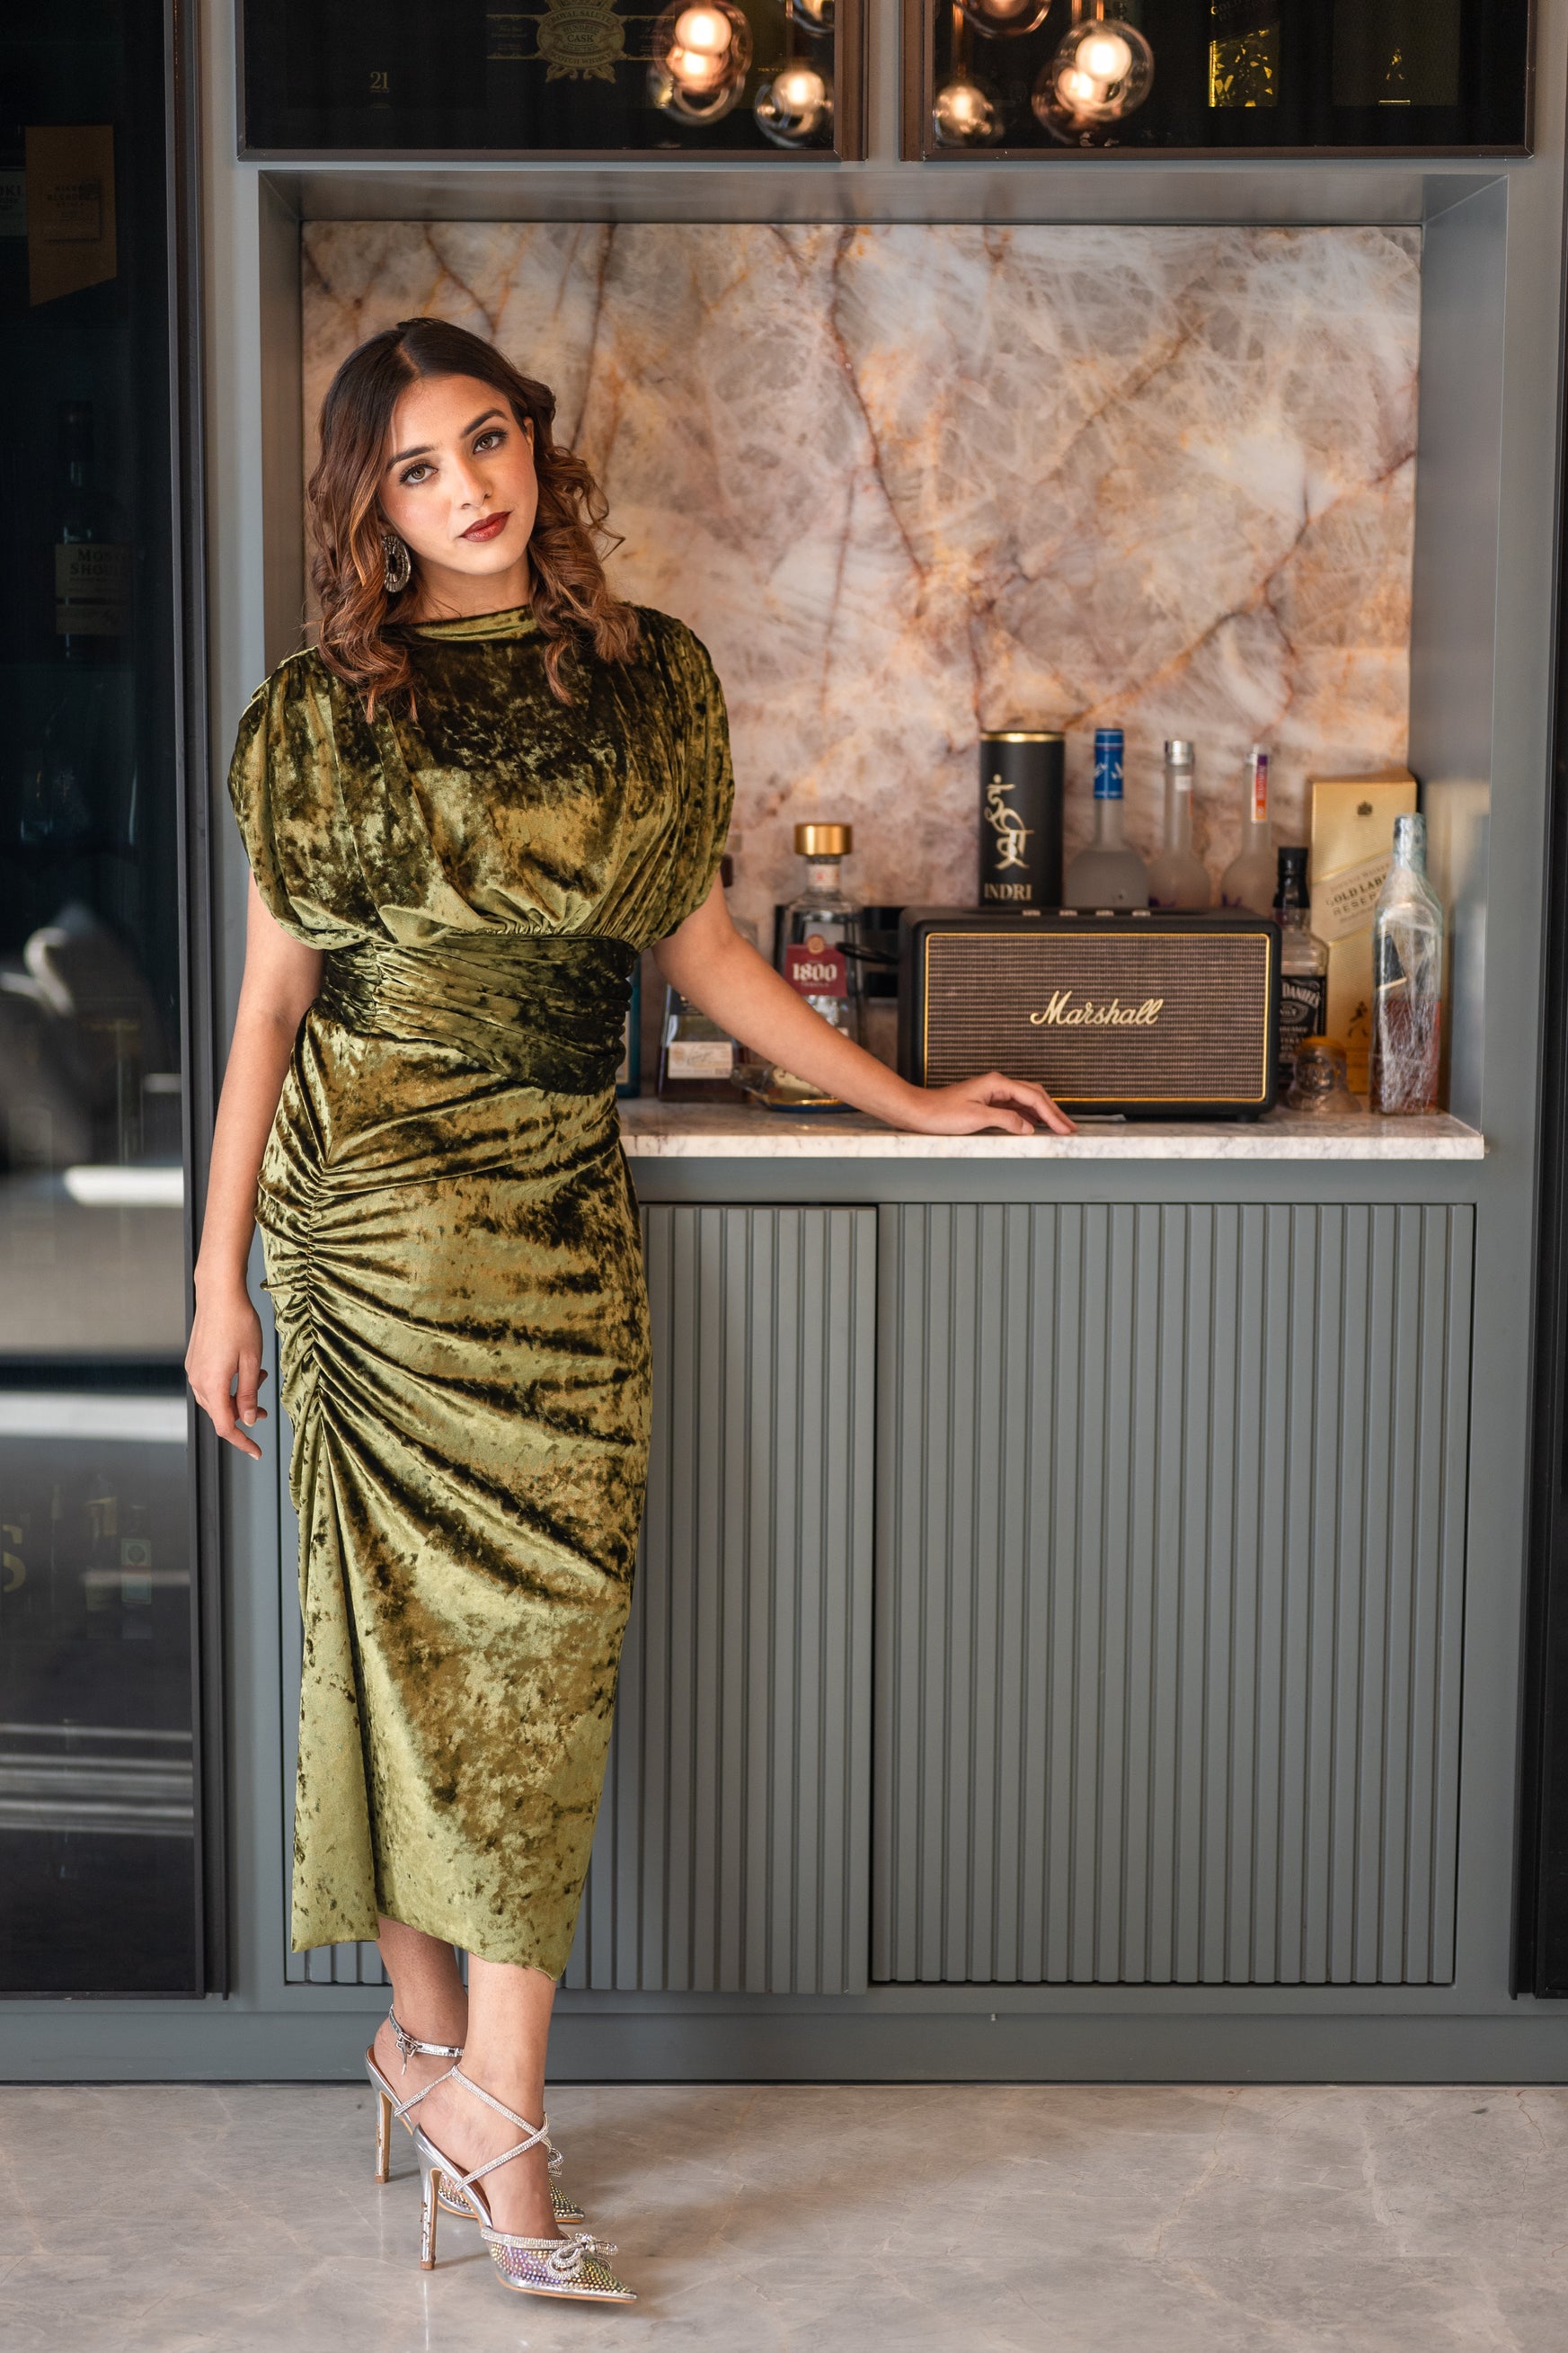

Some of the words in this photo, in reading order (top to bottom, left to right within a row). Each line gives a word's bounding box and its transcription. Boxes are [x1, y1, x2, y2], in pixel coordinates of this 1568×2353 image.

[550, 11, 576, 23] ROYAL
[580, 11, 612, 23] SALUTE
[563, 24, 599, 33] HUNDRED
[567, 34, 594, 43] CASK
[369, 71, 389, 90] 21
[984, 883, 1032, 901] INDRI
[1325, 887, 1358, 908] GOLD
[1333, 891, 1377, 917] RESER
[792, 963, 837, 982] 1800
[1030, 990, 1164, 1025] Marshall
